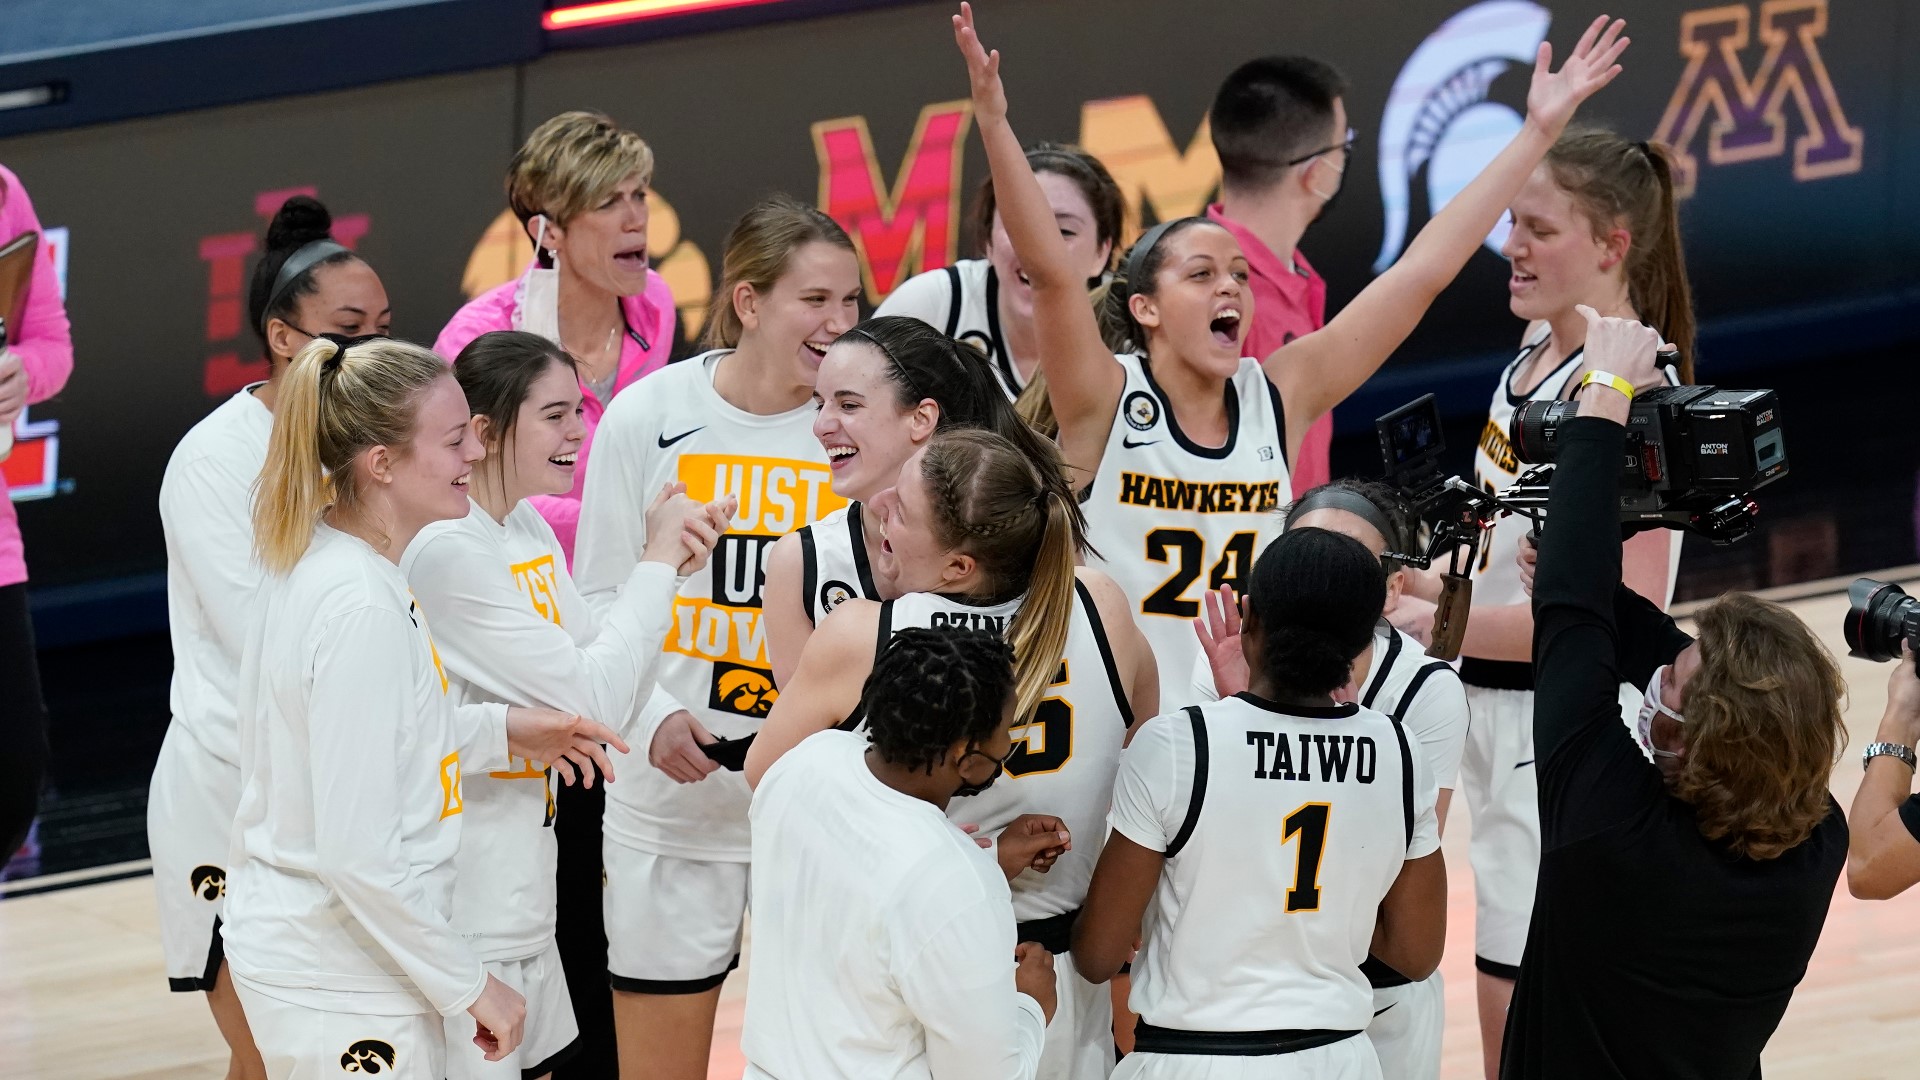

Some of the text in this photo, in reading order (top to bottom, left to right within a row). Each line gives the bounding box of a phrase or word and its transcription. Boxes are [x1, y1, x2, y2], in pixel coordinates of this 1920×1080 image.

[1651, 0, 1864, 199] M
[812, 98, 974, 307] M
[1119, 471, 1280, 513] HAWKEYES
[1141, 527, 1258, 620] 24
[1246, 731, 1377, 784] TAIWO
[1281, 801, 1332, 914] 1
